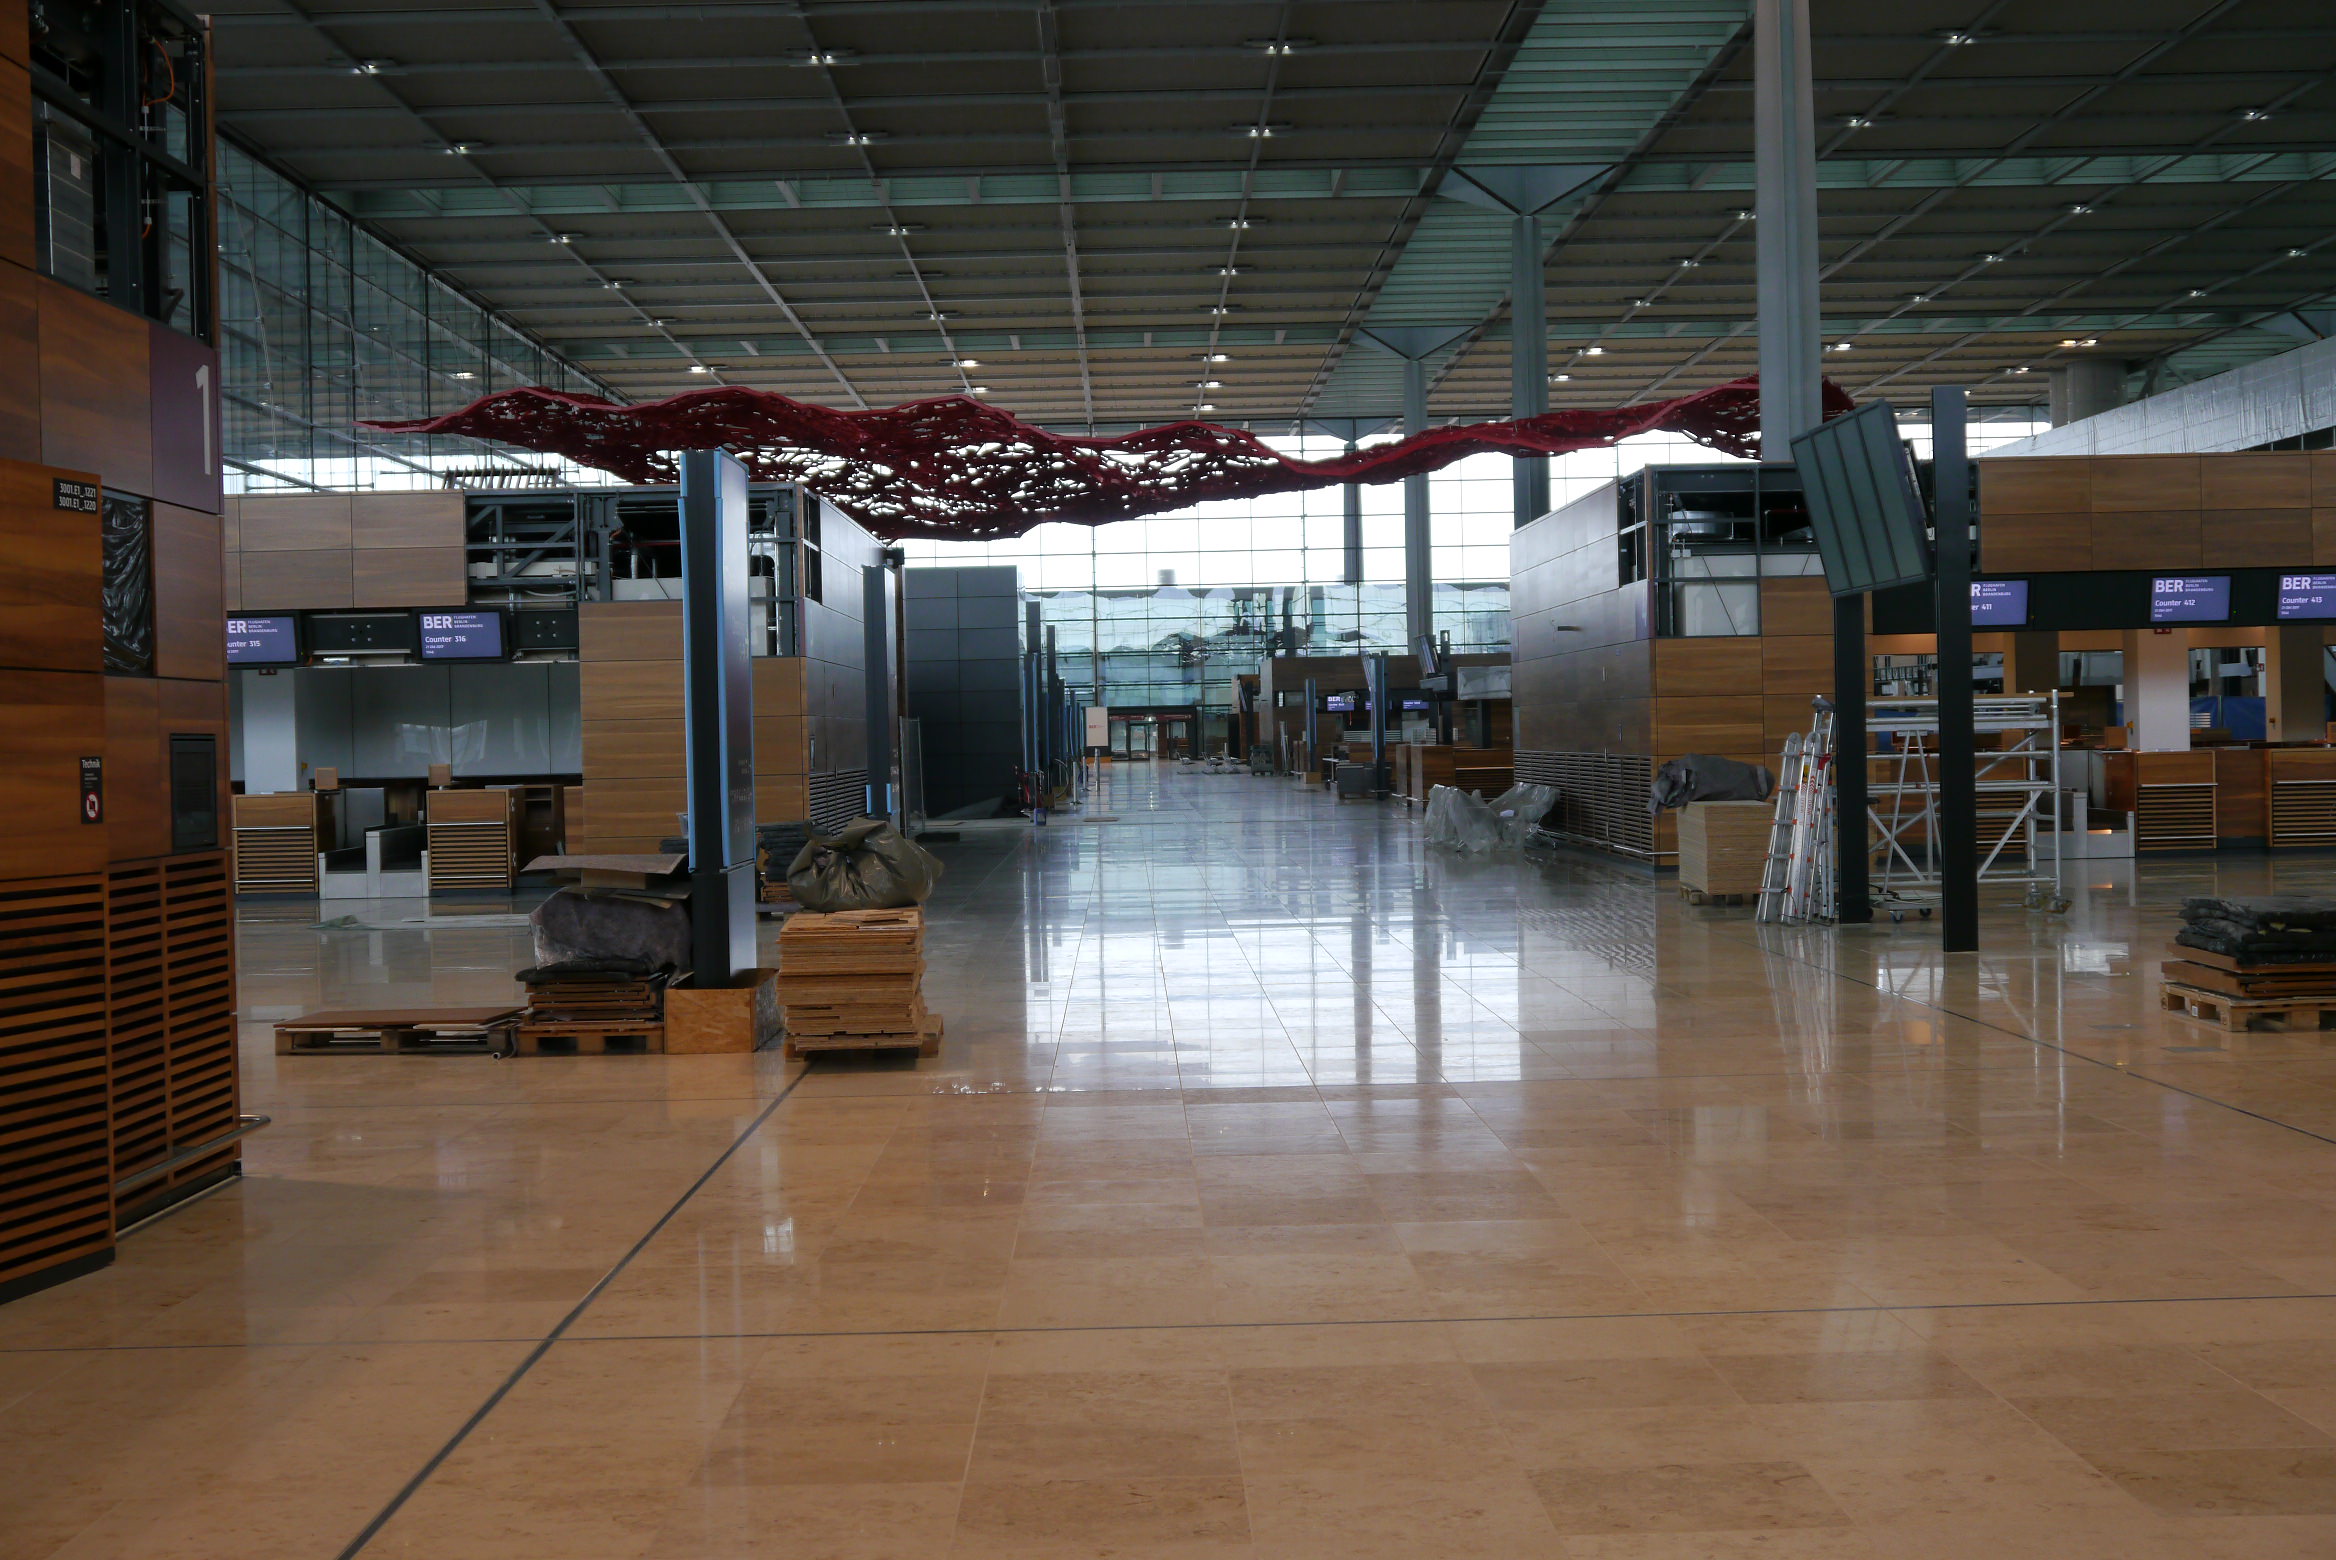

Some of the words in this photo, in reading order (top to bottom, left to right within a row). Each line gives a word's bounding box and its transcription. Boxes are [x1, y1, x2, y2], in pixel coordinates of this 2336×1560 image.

[195, 364, 212, 476] 1
[2155, 579, 2184, 593] BER
[2282, 577, 2311, 590] BER
[1981, 603, 1993, 611] 411
[2155, 599, 2182, 607] Counter
[227, 620, 247, 634] ER
[423, 615, 453, 629] BER
[454, 635, 467, 643] 316
[81, 759, 101, 769] Technik
